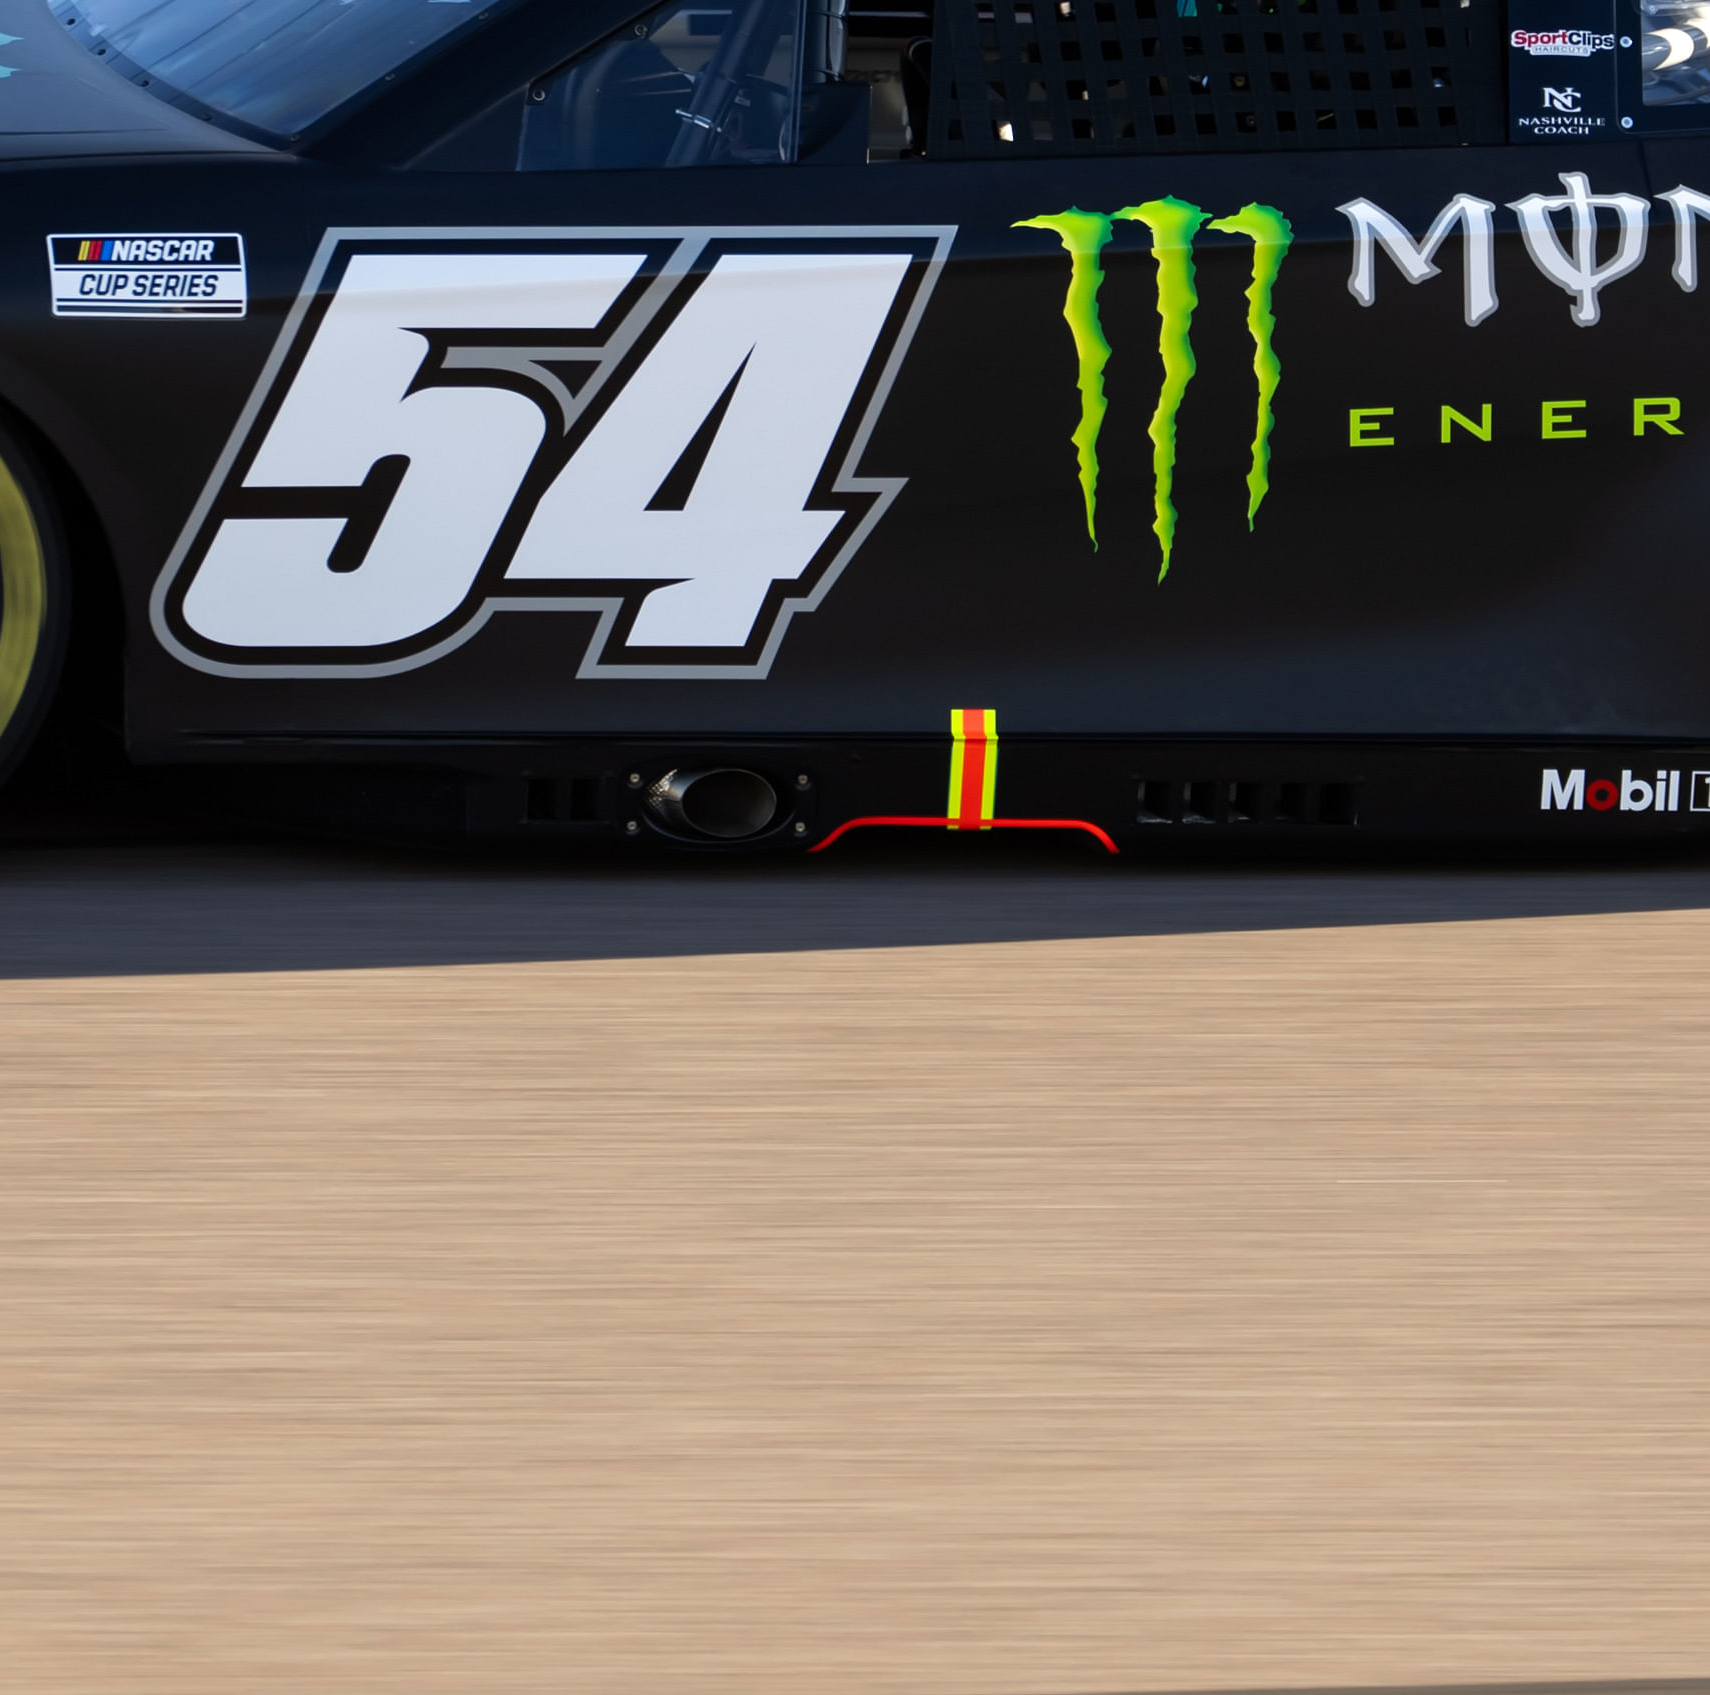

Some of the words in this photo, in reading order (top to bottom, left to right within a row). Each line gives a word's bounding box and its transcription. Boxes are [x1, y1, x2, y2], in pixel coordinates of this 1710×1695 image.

[1518, 116, 1606, 126] NASHVILLE
[1533, 126, 1590, 135] COACH
[110, 240, 215, 261] NASCAR
[79, 274, 129, 296] CUP
[132, 274, 219, 297] SERIES
[151, 227, 957, 679] 54
[1540, 768, 1681, 812] Mobil
